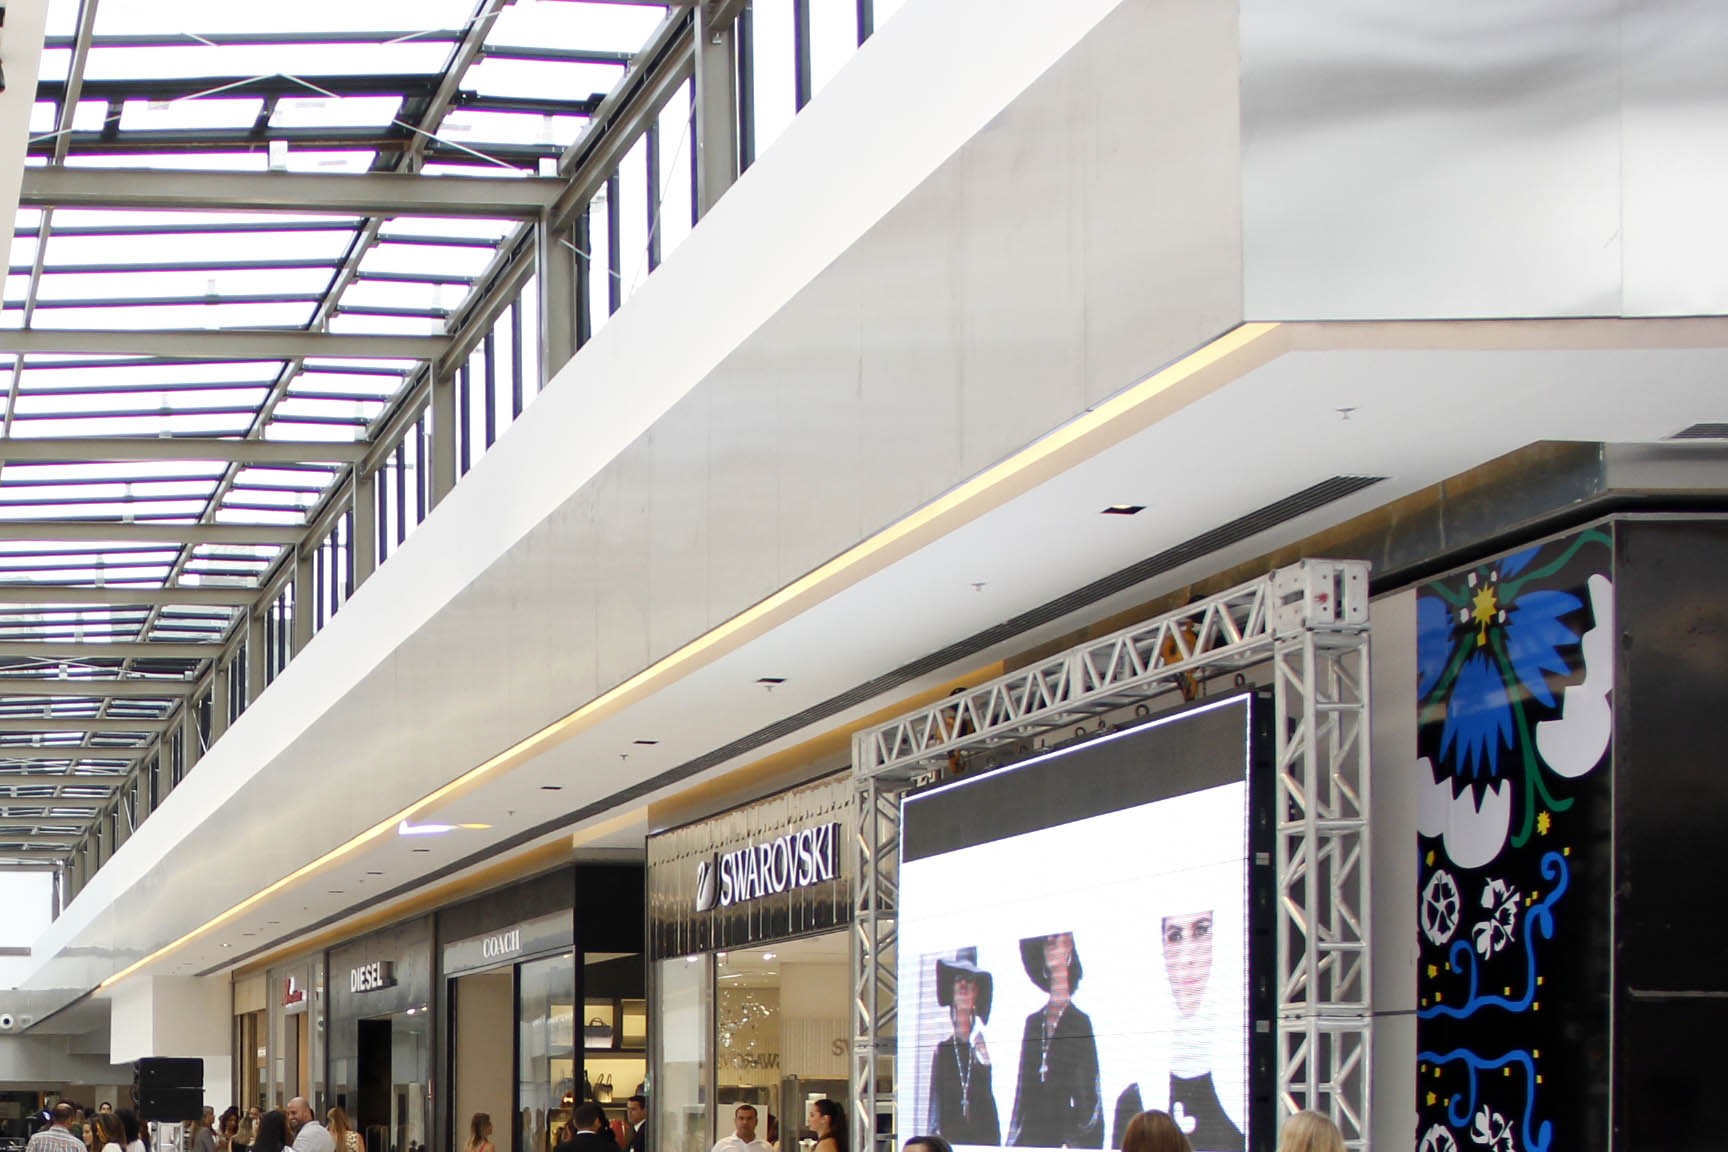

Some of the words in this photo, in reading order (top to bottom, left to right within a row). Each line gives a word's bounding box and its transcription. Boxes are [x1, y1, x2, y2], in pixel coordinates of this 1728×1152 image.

[720, 822, 836, 907] SWAROVSKI
[483, 928, 521, 959] COACH
[350, 960, 383, 993] DIESEL
